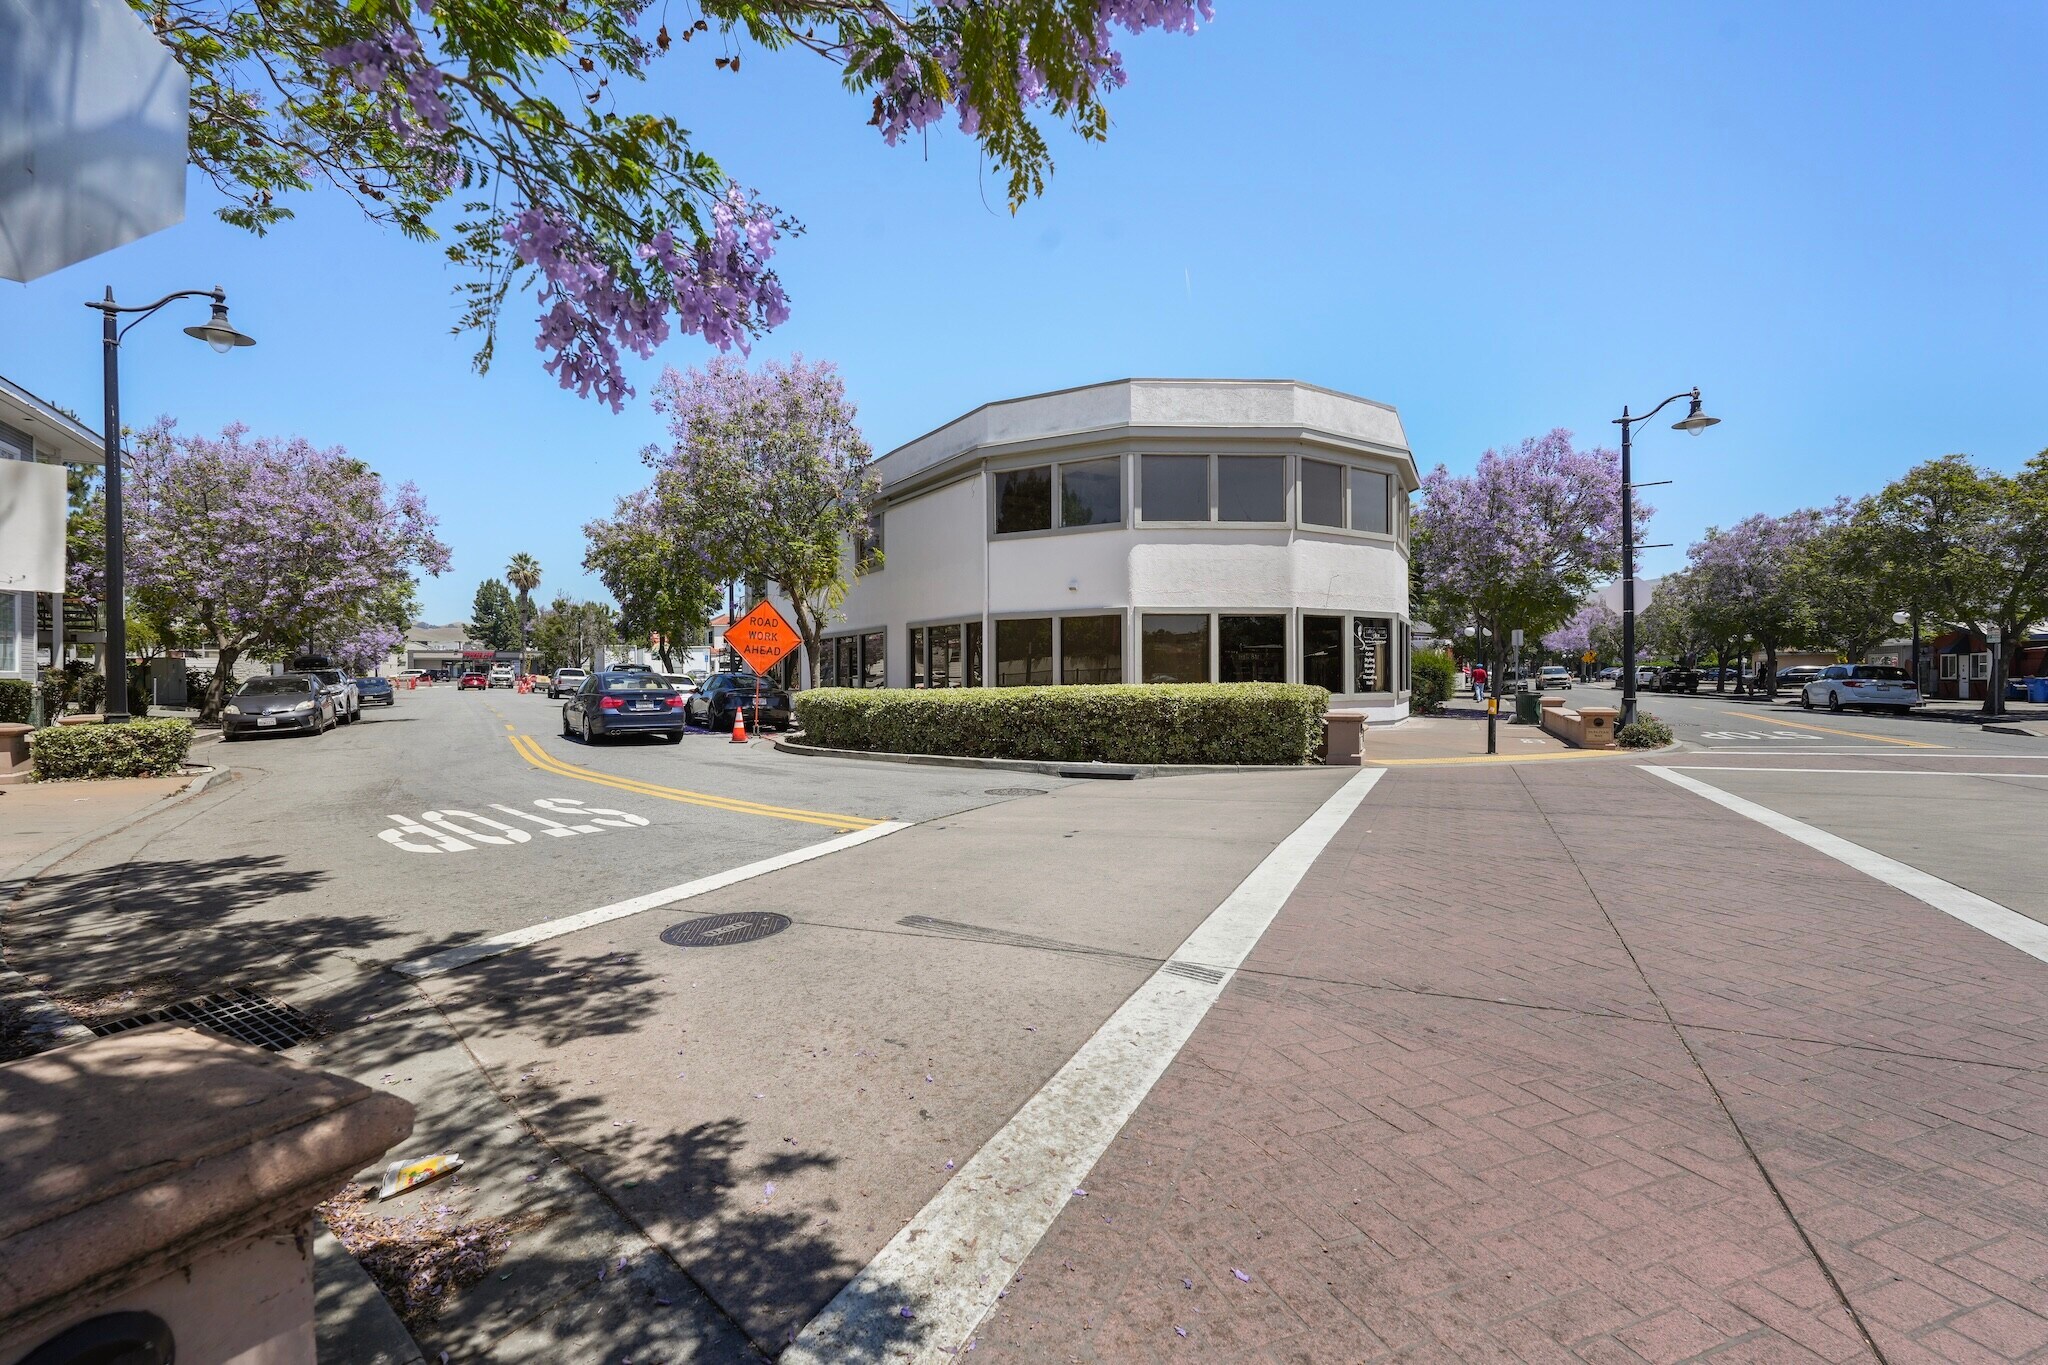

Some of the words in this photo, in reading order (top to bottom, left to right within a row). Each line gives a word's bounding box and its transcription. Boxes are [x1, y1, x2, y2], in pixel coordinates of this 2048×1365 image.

[750, 617, 779, 628] ROAD
[748, 631, 778, 642] WORK
[744, 644, 780, 656] AHEAD
[1700, 731, 1824, 740] STOP
[377, 798, 650, 854] STOP
